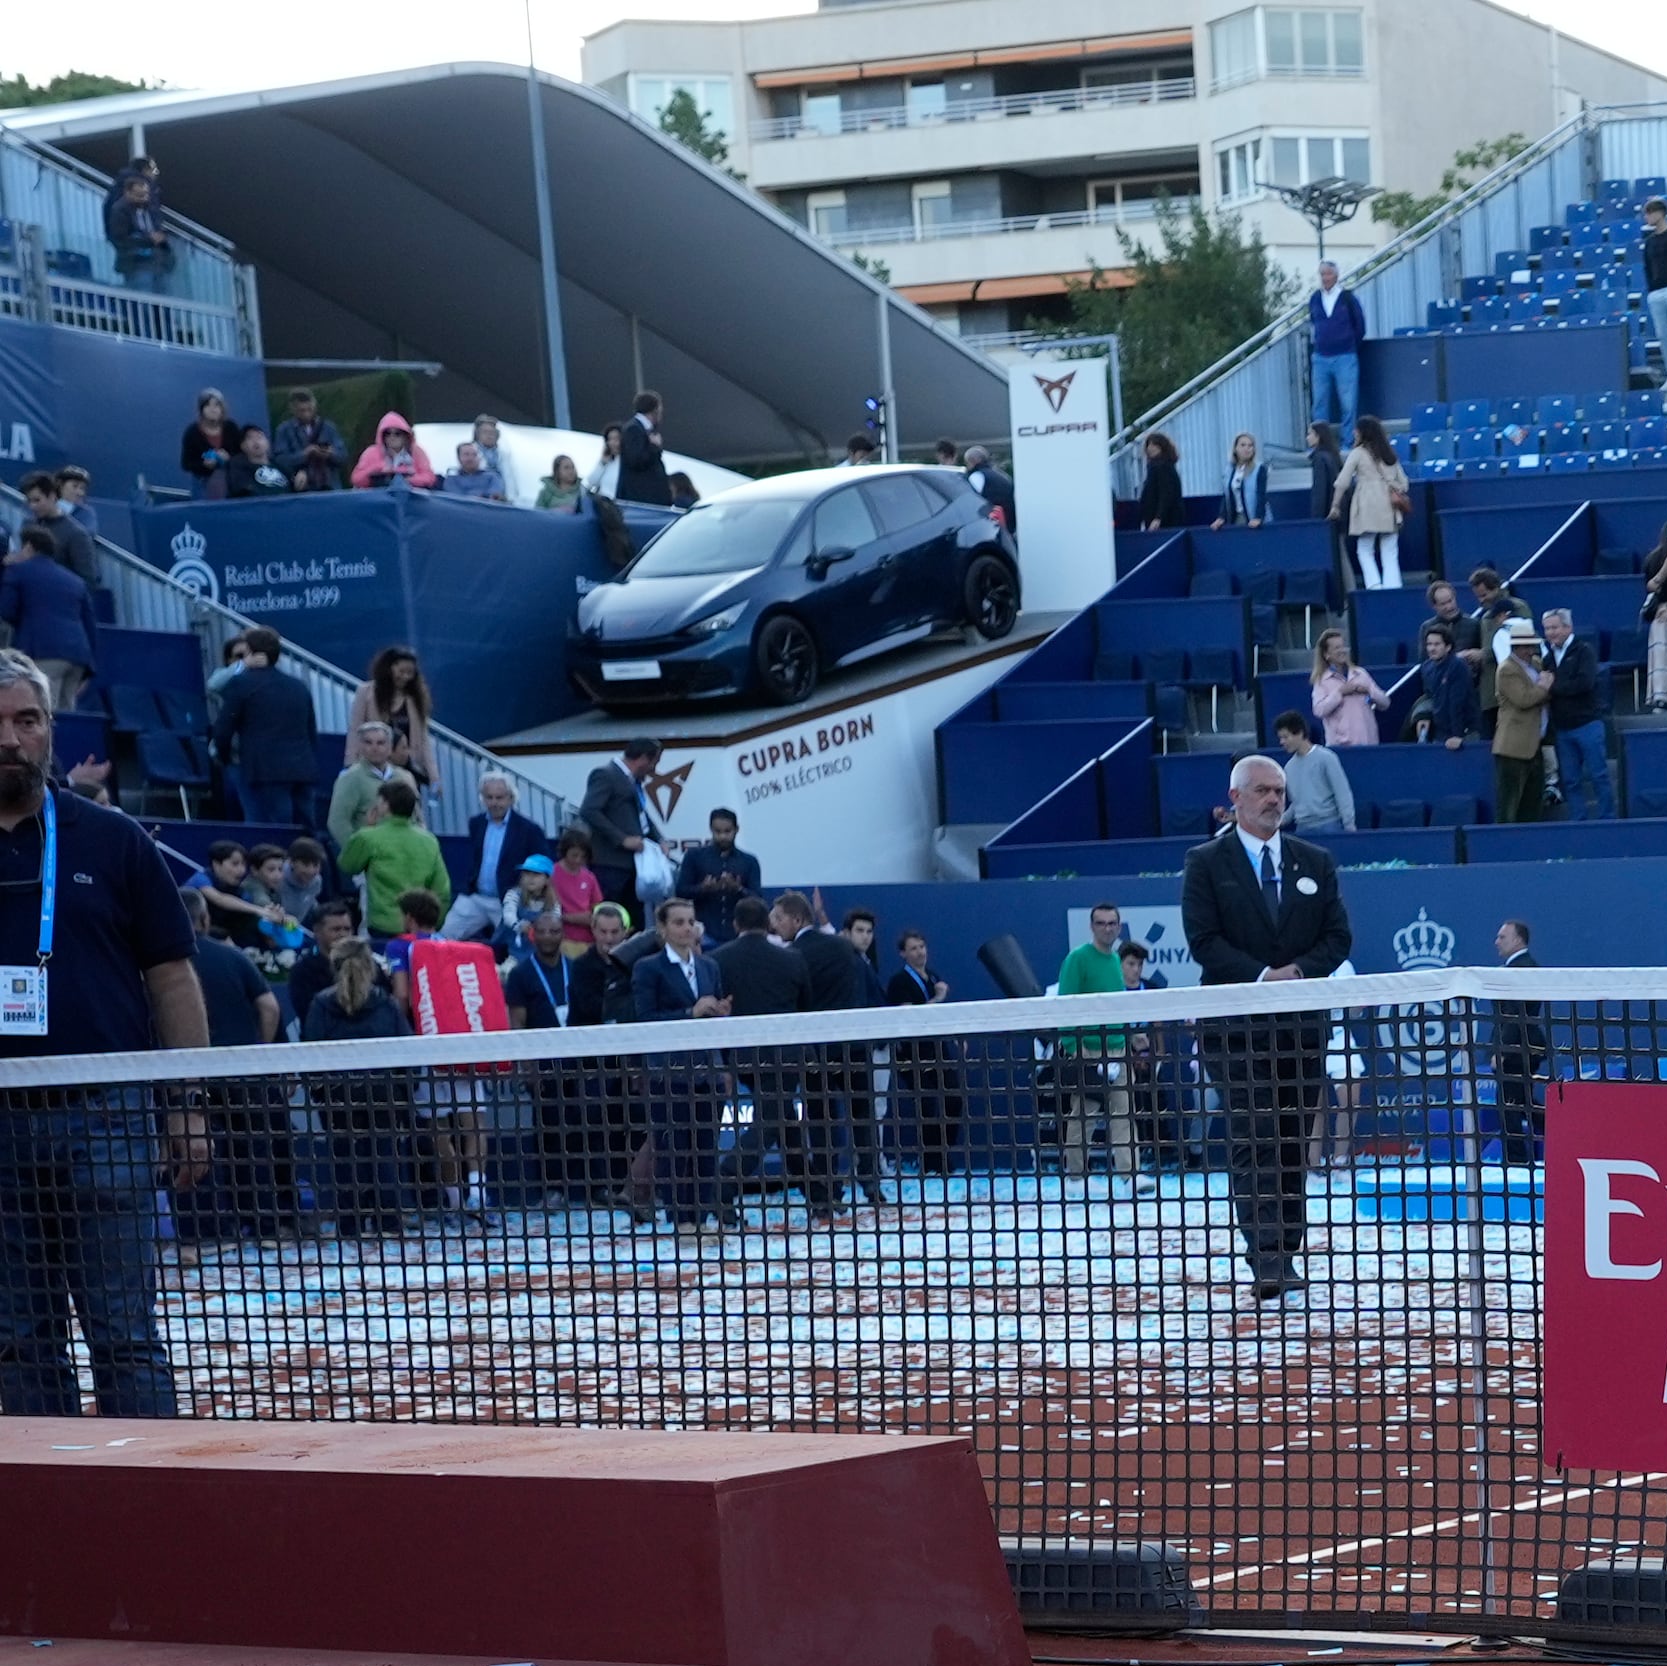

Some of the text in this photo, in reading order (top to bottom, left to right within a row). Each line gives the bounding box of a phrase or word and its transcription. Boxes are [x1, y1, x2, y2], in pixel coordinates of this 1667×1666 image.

[1018, 421, 1097, 437] CUPRA
[265, 560, 304, 584] Club
[306, 558, 325, 581] de
[325, 556, 377, 579] Tennis
[738, 713, 875, 777] CUPRA BORN
[744, 779, 782, 804] 100%
